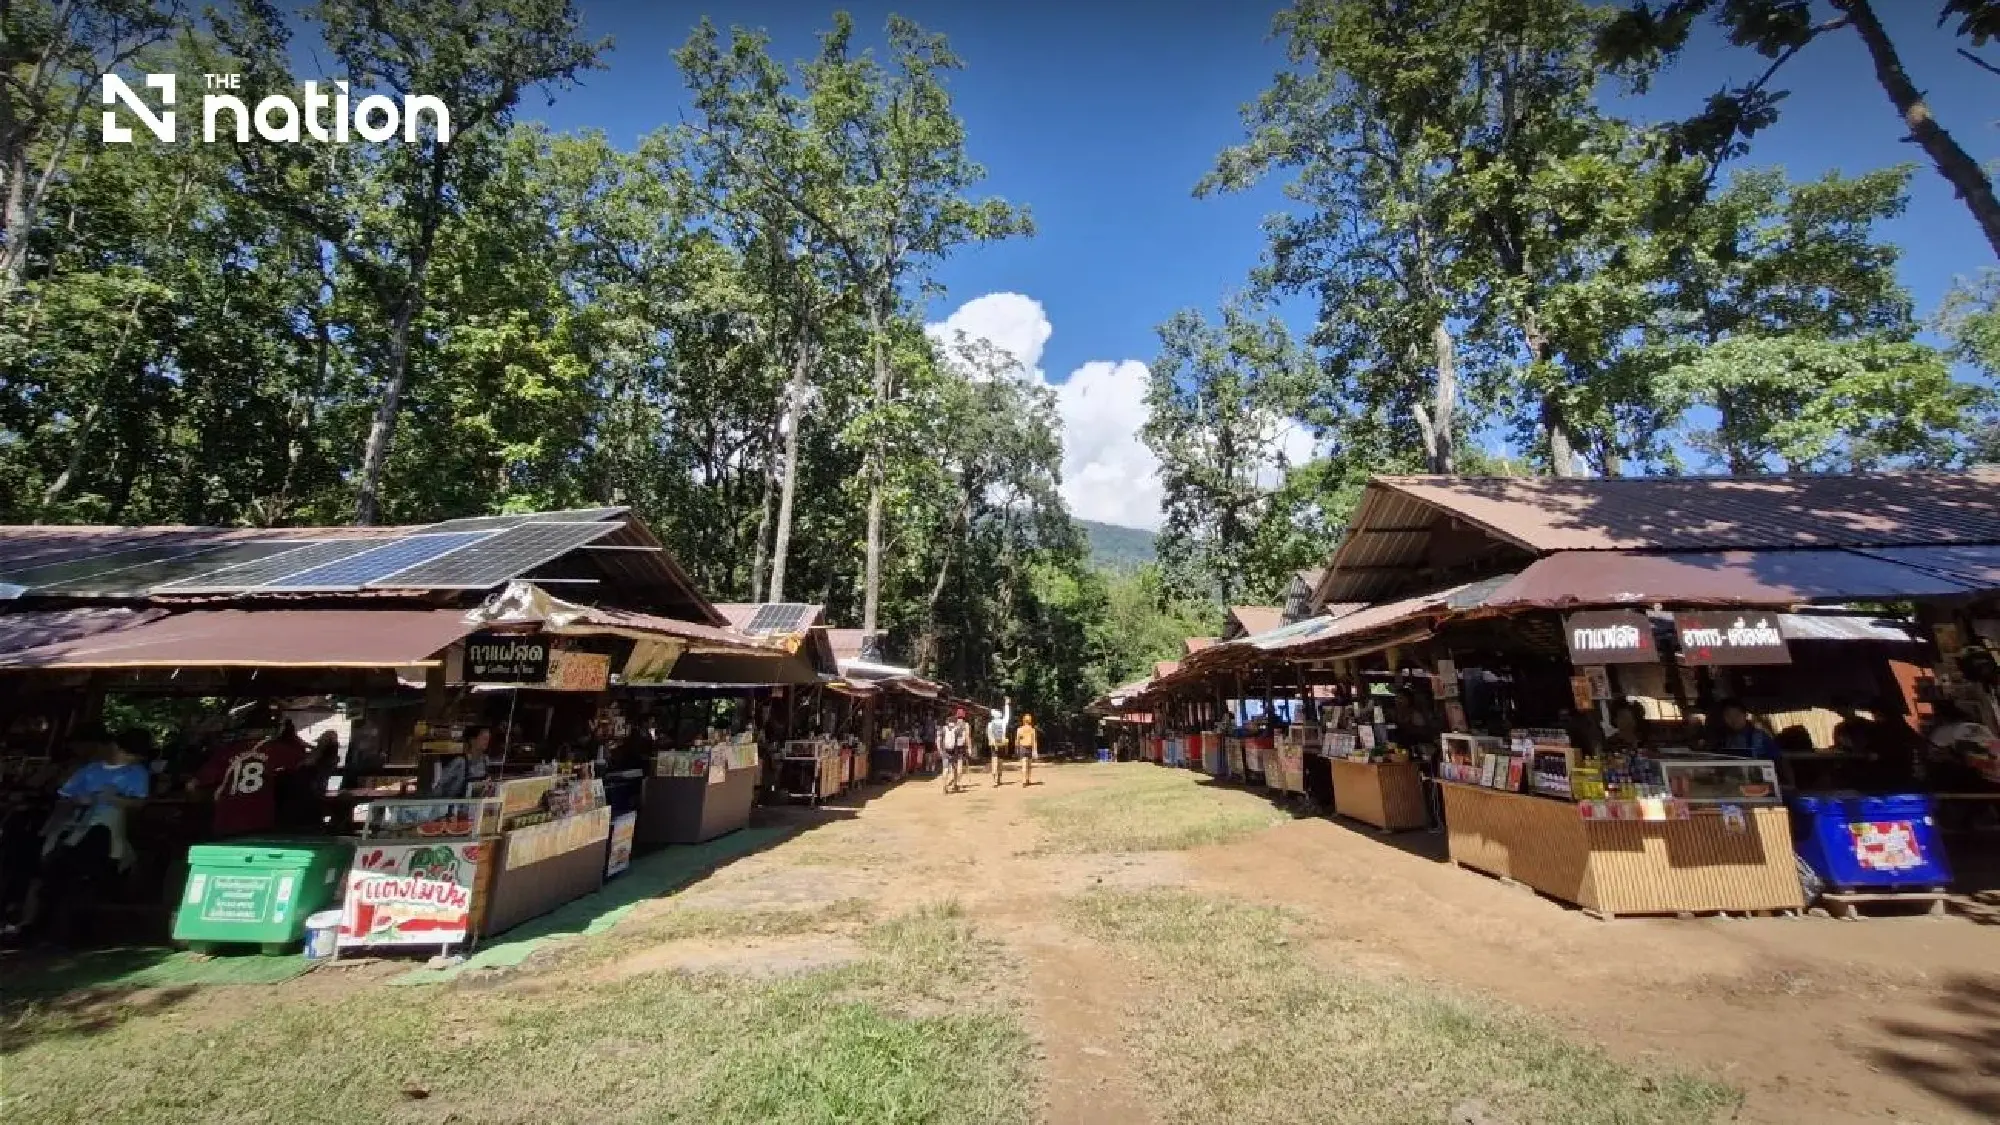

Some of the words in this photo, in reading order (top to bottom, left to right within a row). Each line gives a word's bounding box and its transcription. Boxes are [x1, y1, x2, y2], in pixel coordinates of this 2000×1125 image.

[470, 641, 543, 661] กาแฟสด
[229, 755, 264, 794] 18
[366, 862, 466, 908] แตงโมปั่น
